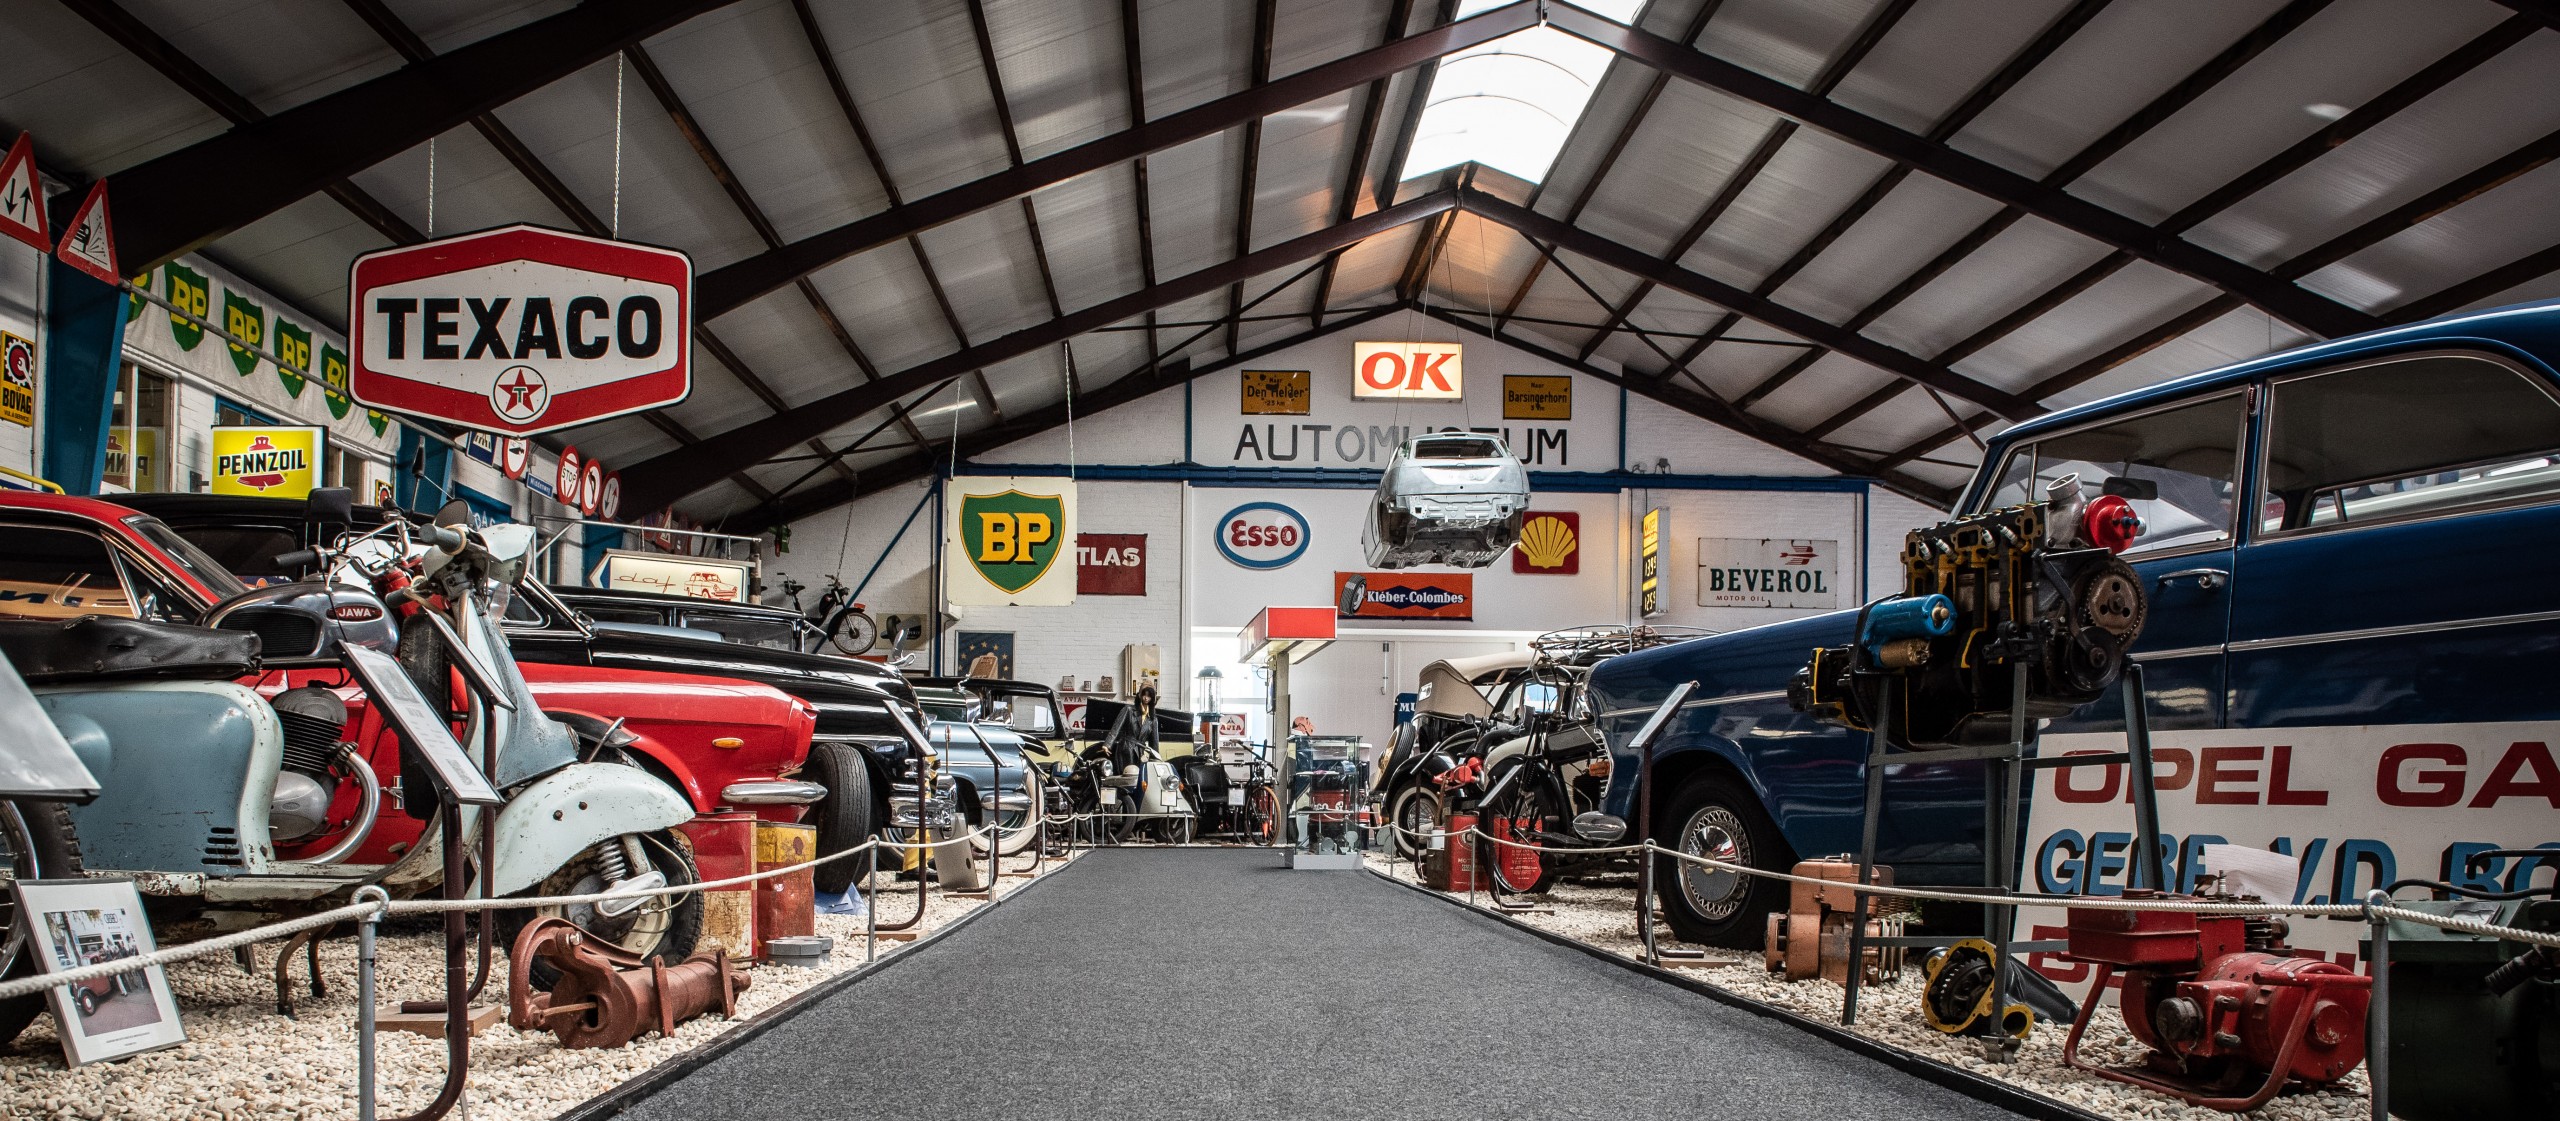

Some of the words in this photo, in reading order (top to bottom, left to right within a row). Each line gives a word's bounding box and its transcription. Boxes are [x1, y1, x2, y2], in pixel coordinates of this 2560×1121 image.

[376, 295, 662, 360] TEXACO
[1361, 351, 1457, 392] OK
[2, 386, 32, 415] BOVAG
[1247, 385, 1267, 398] Den
[1508, 390, 1568, 405] Barsingerhorn
[1233, 423, 1568, 466] AUTOMUM
[218, 449, 307, 476] PENNZOIL
[561, 467, 577, 485] STOP
[978, 512, 1054, 566] BP
[1077, 547, 1141, 567] TLAS
[1710, 568, 1828, 593] BEVEROL
[1366, 591, 1464, 604] Kléber-Colombes
[338, 608, 372, 617] JAWA
[2054, 744, 2329, 807] OPEL
